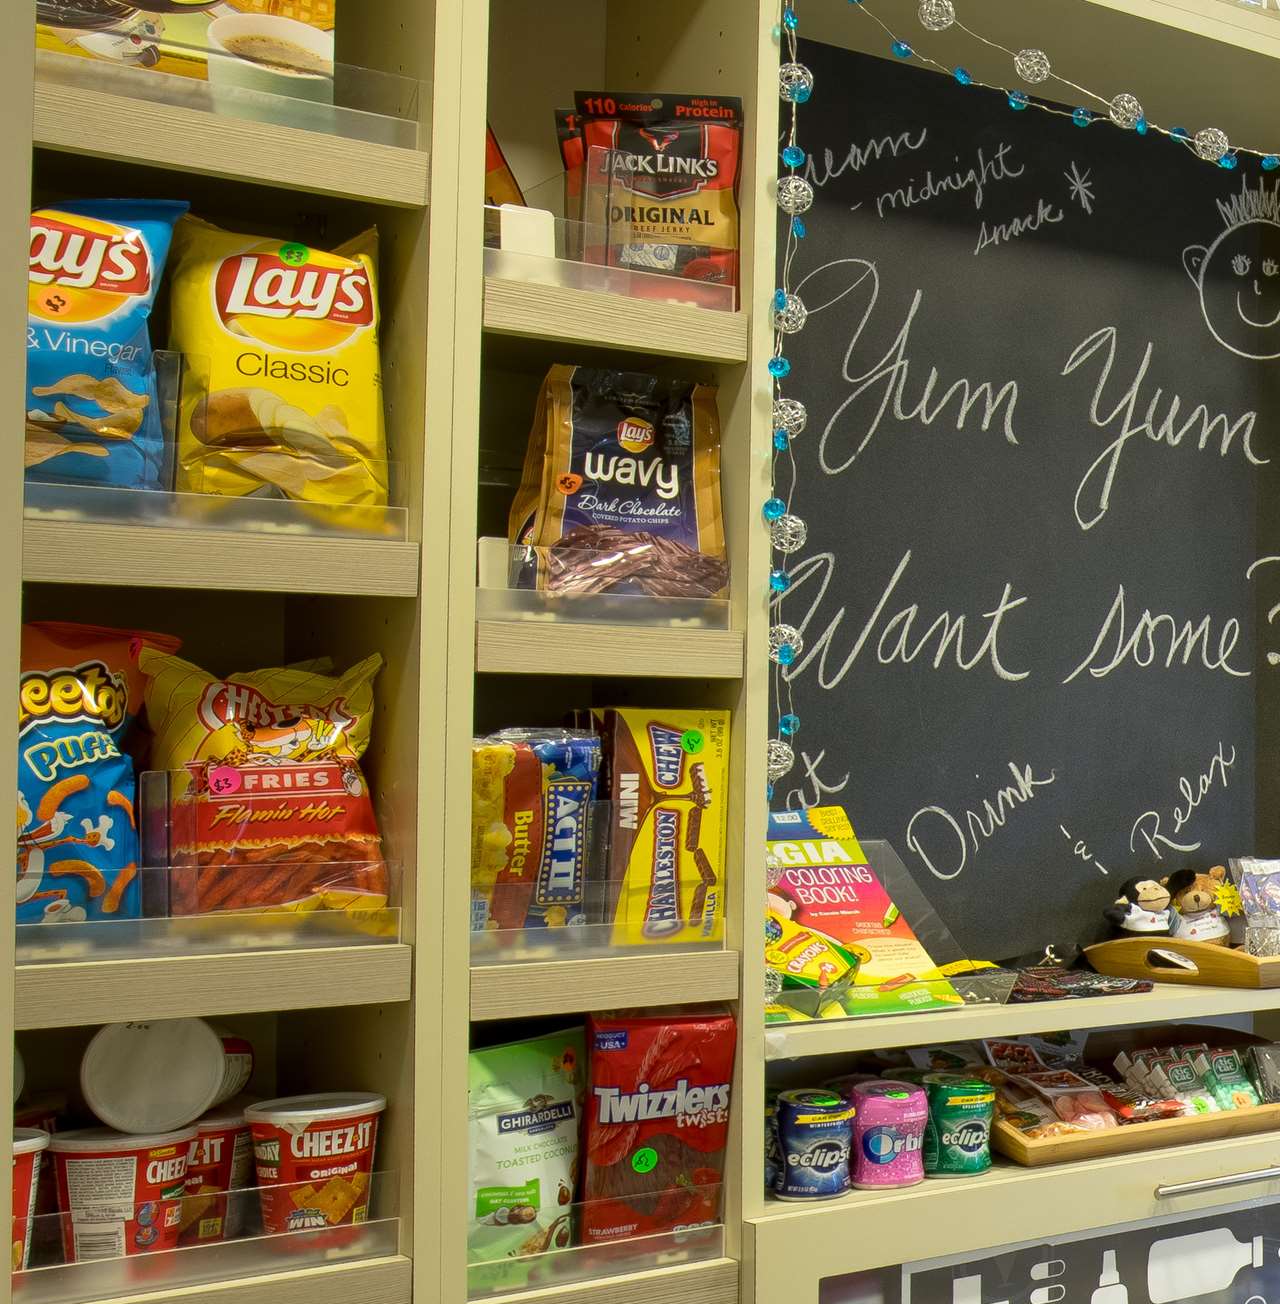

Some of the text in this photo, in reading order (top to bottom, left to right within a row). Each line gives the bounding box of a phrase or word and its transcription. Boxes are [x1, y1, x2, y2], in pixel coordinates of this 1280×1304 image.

[585, 98, 616, 114] 110
[676, 106, 733, 118] Protein
[601, 151, 718, 177] JACK LINK'S
[610, 206, 715, 226] ORIGINAL
[29, 226, 141, 288] ay's
[225, 256, 368, 319] Lay's
[43, 329, 142, 363] Vinegar
[236, 352, 349, 387] Classic
[796, 257, 1270, 530] Yum Yum
[620, 422, 653, 443] Lay's
[584, 451, 679, 499] wavy
[577, 494, 682, 517] Dark Chocolate
[20, 664, 127, 729] eetos
[244, 771, 329, 789] FRIES
[210, 801, 346, 828] Flamin' Hot
[620, 773, 640, 829] MINI
[906, 761, 1055, 880] Drink
[1130, 741, 1236, 860] Relax
[556, 795, 580, 852] ACT
[510, 810, 533, 877] Butter
[644, 811, 681, 937] CHARLESTON
[797, 886, 860, 905] BOOK!
[787, 940, 829, 973] CRAYONS
[501, 1105, 573, 1130] GHIRARDELLI
[593, 1080, 729, 1124] Twizzlers
[863, 1125, 924, 1164] Orbi
